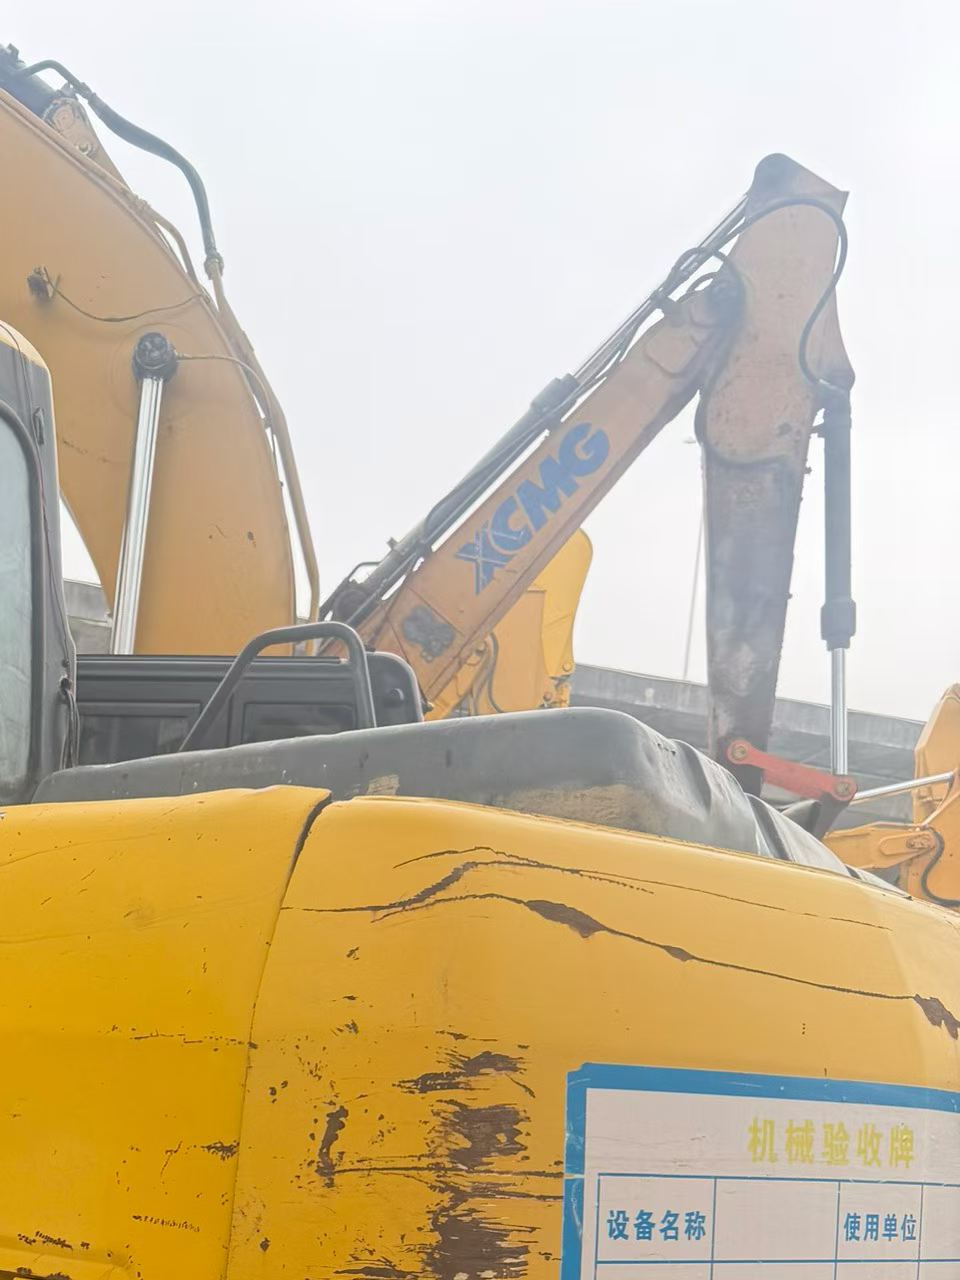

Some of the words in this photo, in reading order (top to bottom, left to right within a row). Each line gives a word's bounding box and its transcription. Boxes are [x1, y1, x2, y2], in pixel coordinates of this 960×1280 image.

[456, 423, 610, 594] XCMG
[748, 1119, 915, 1168] 机械验收牌
[606, 1209, 707, 1242] 设备名称
[843, 1212, 918, 1243] 使用单位
